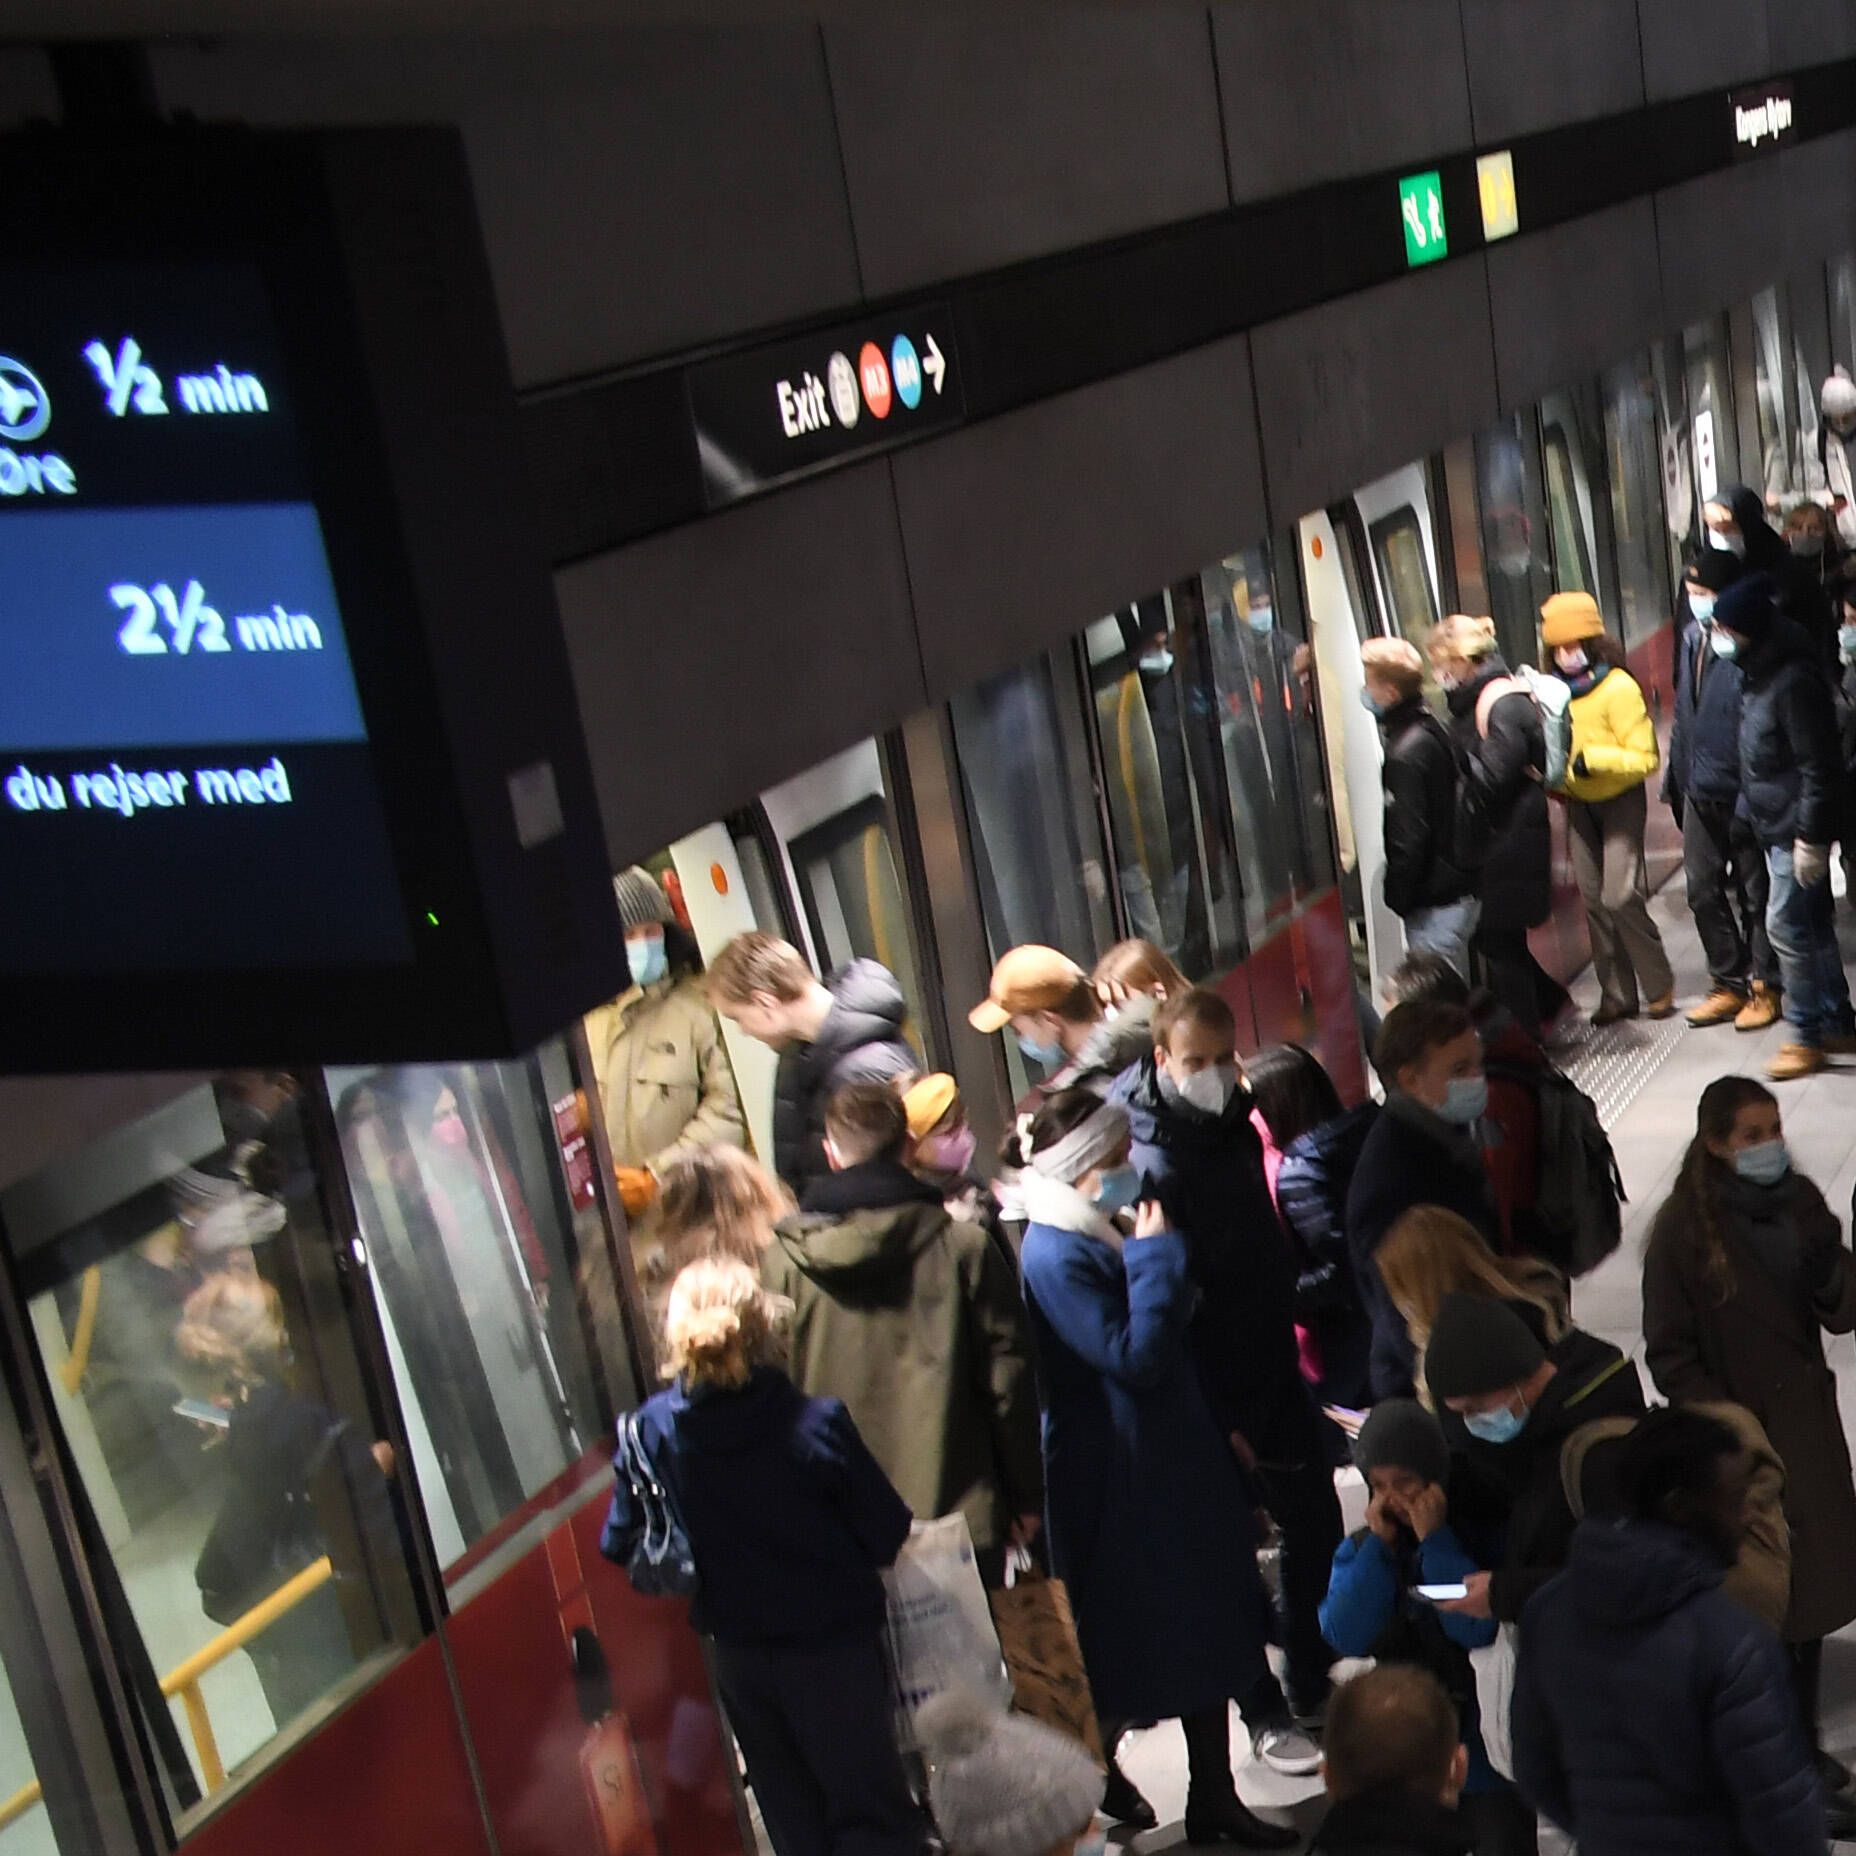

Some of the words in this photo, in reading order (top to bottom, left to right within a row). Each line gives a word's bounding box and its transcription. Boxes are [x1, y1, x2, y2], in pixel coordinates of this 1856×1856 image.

[177, 363, 270, 412] min
[776, 370, 830, 438] Exit
[235, 604, 323, 652] min
[5, 764, 67, 811] du
[71, 762, 188, 817] rejser
[194, 756, 292, 804] med
